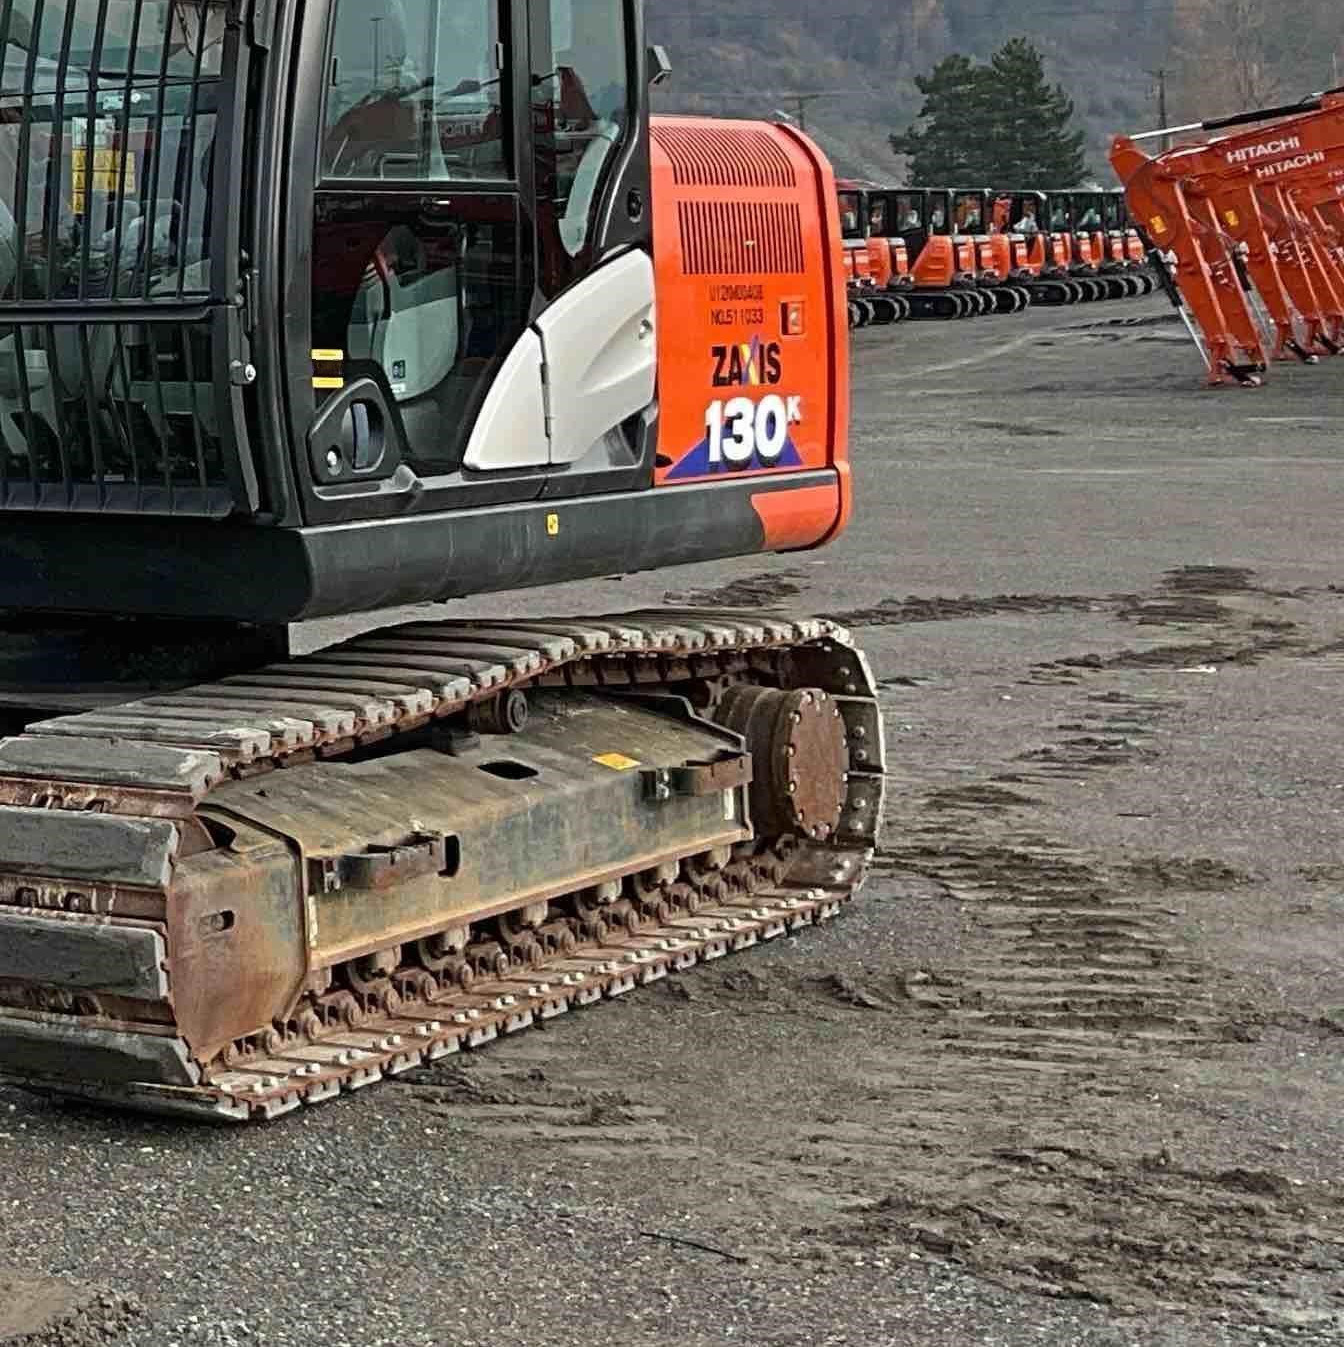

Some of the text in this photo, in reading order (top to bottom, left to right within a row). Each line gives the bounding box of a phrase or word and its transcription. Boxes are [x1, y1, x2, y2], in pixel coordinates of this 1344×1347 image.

[1226, 136, 1301, 164] HITACHI
[1255, 151, 1326, 179] HITACHI
[710, 334, 782, 388] ZAXIS
